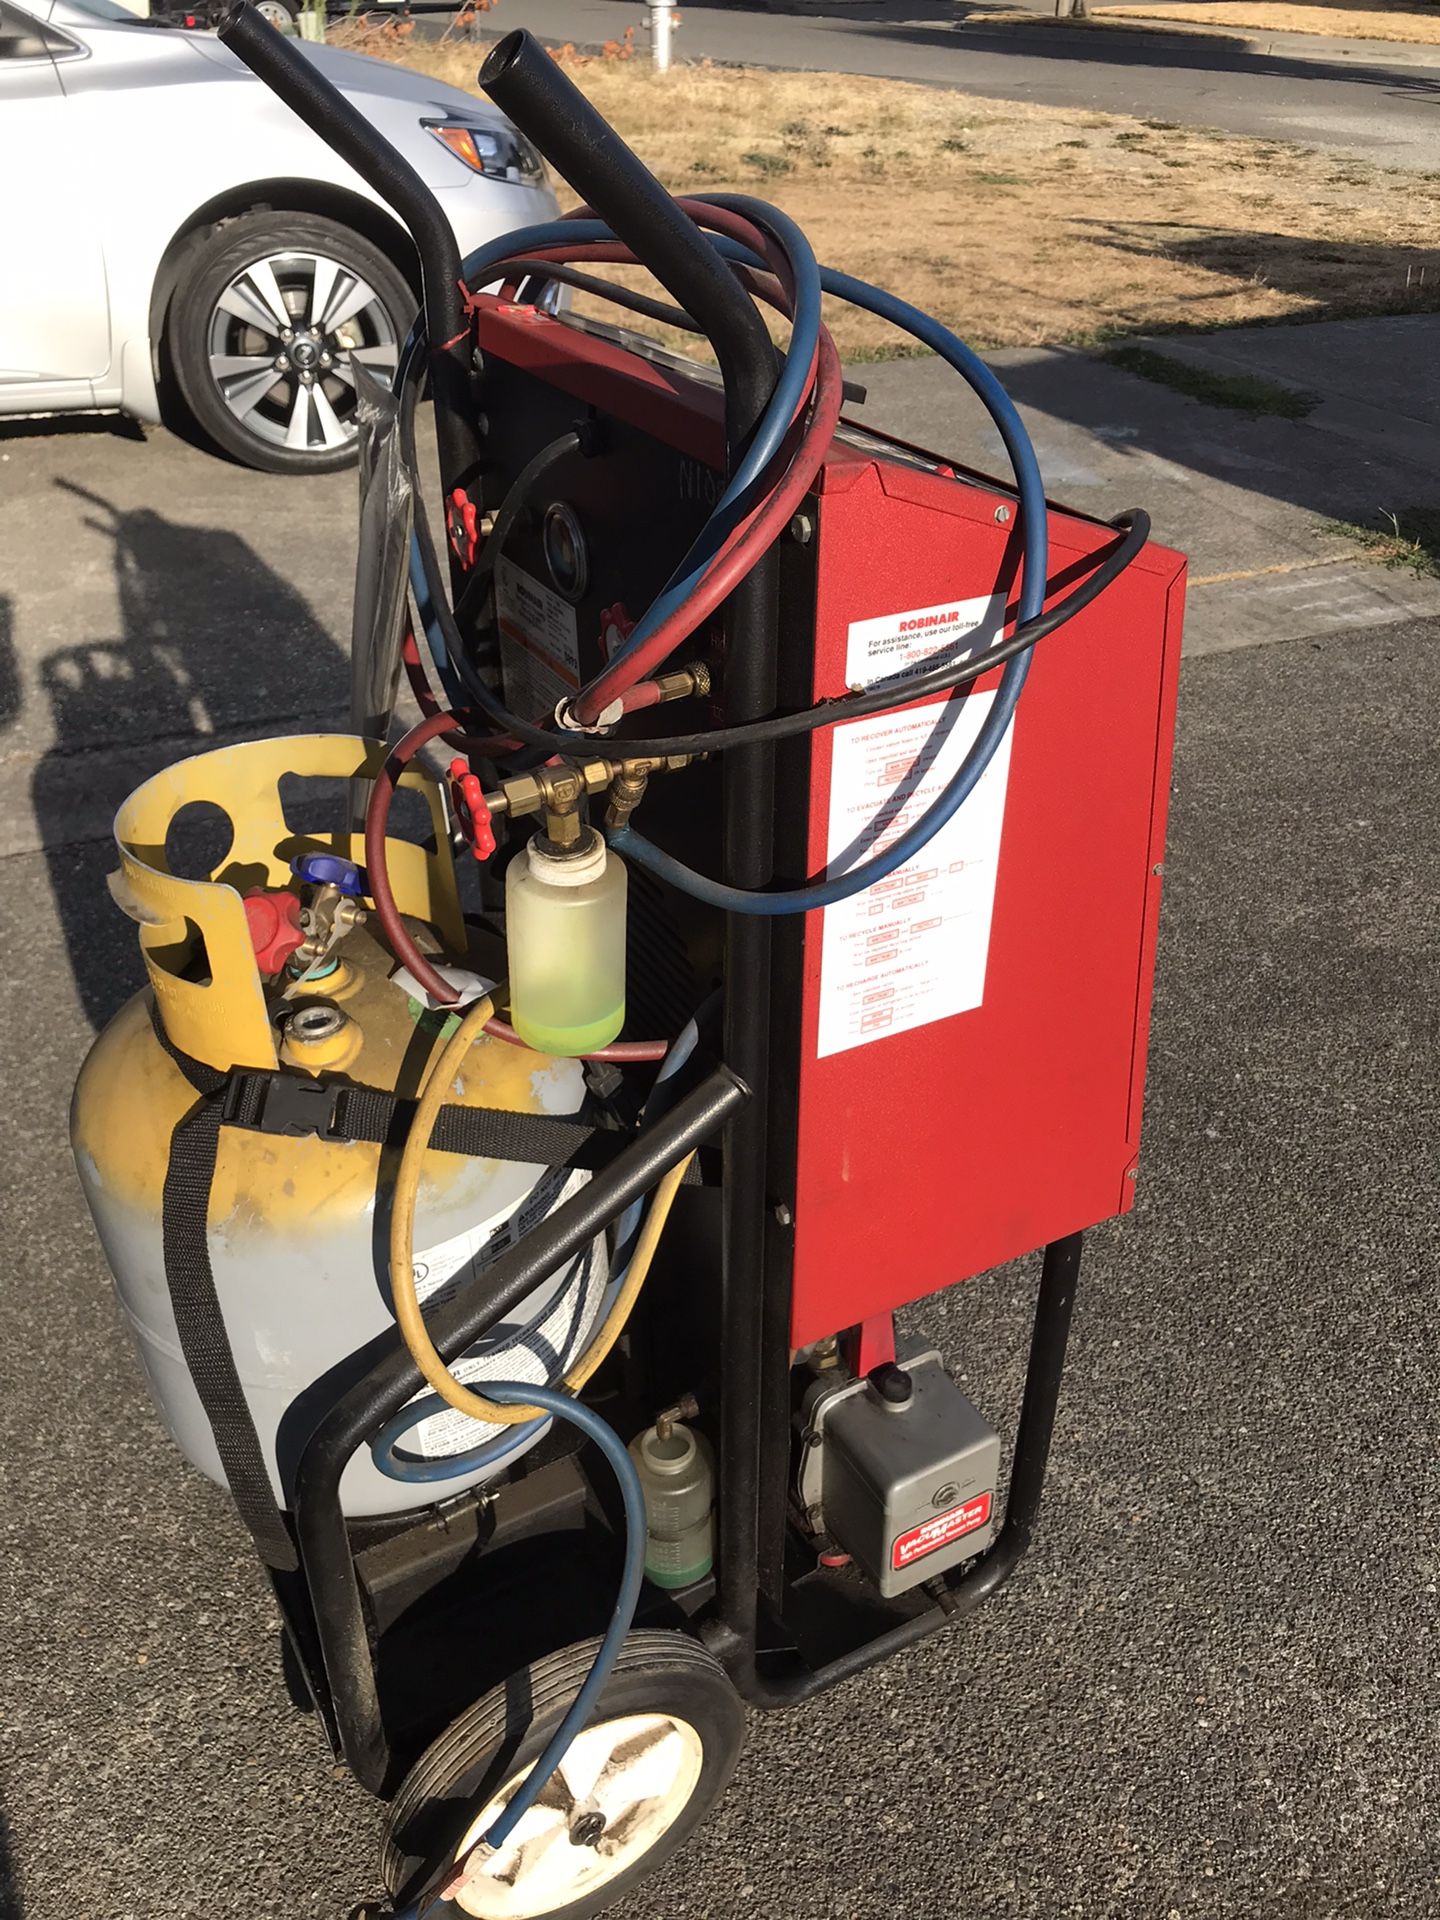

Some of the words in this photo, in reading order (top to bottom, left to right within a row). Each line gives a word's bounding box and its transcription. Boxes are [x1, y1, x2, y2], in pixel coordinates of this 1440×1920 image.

[899, 611, 960, 633] ROBINAIR
[868, 639, 881, 649] For
[882, 631, 923, 647] assistance,
[924, 628, 938, 638] use
[939, 625, 951, 635] our
[867, 645, 894, 657] service
[875, 671, 900, 684] Canada
[901, 667, 914, 679] call
[851, 736, 860, 745] TO
[861, 729, 894, 742] RECOVER
[892, 793, 906, 802] AND
